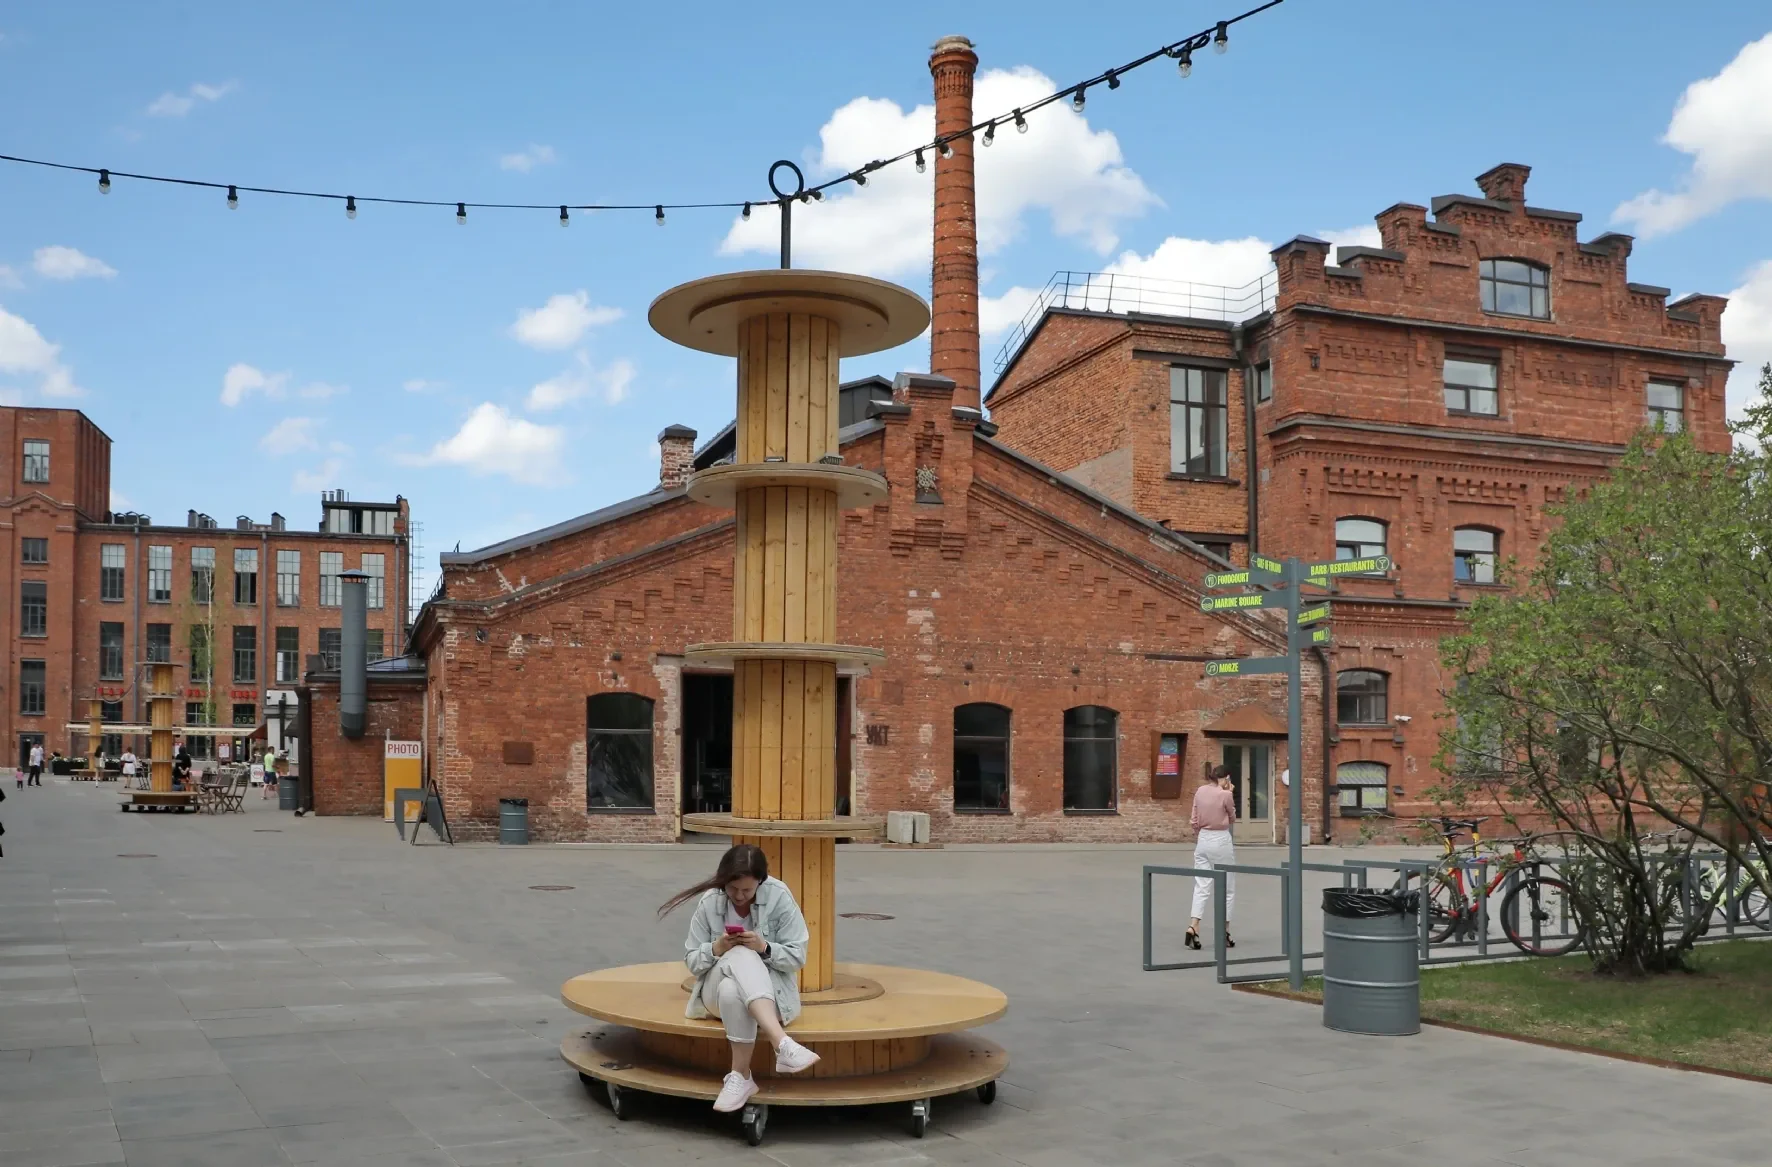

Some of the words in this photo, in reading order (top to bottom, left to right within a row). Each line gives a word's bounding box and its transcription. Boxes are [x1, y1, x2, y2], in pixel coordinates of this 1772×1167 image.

[1217, 572, 1250, 585] FOODCOURT
[1214, 597, 1238, 609] MARINE
[1238, 595, 1263, 607] SQUARE
[1218, 662, 1239, 673] MORZE
[387, 743, 419, 755] PHOTO
